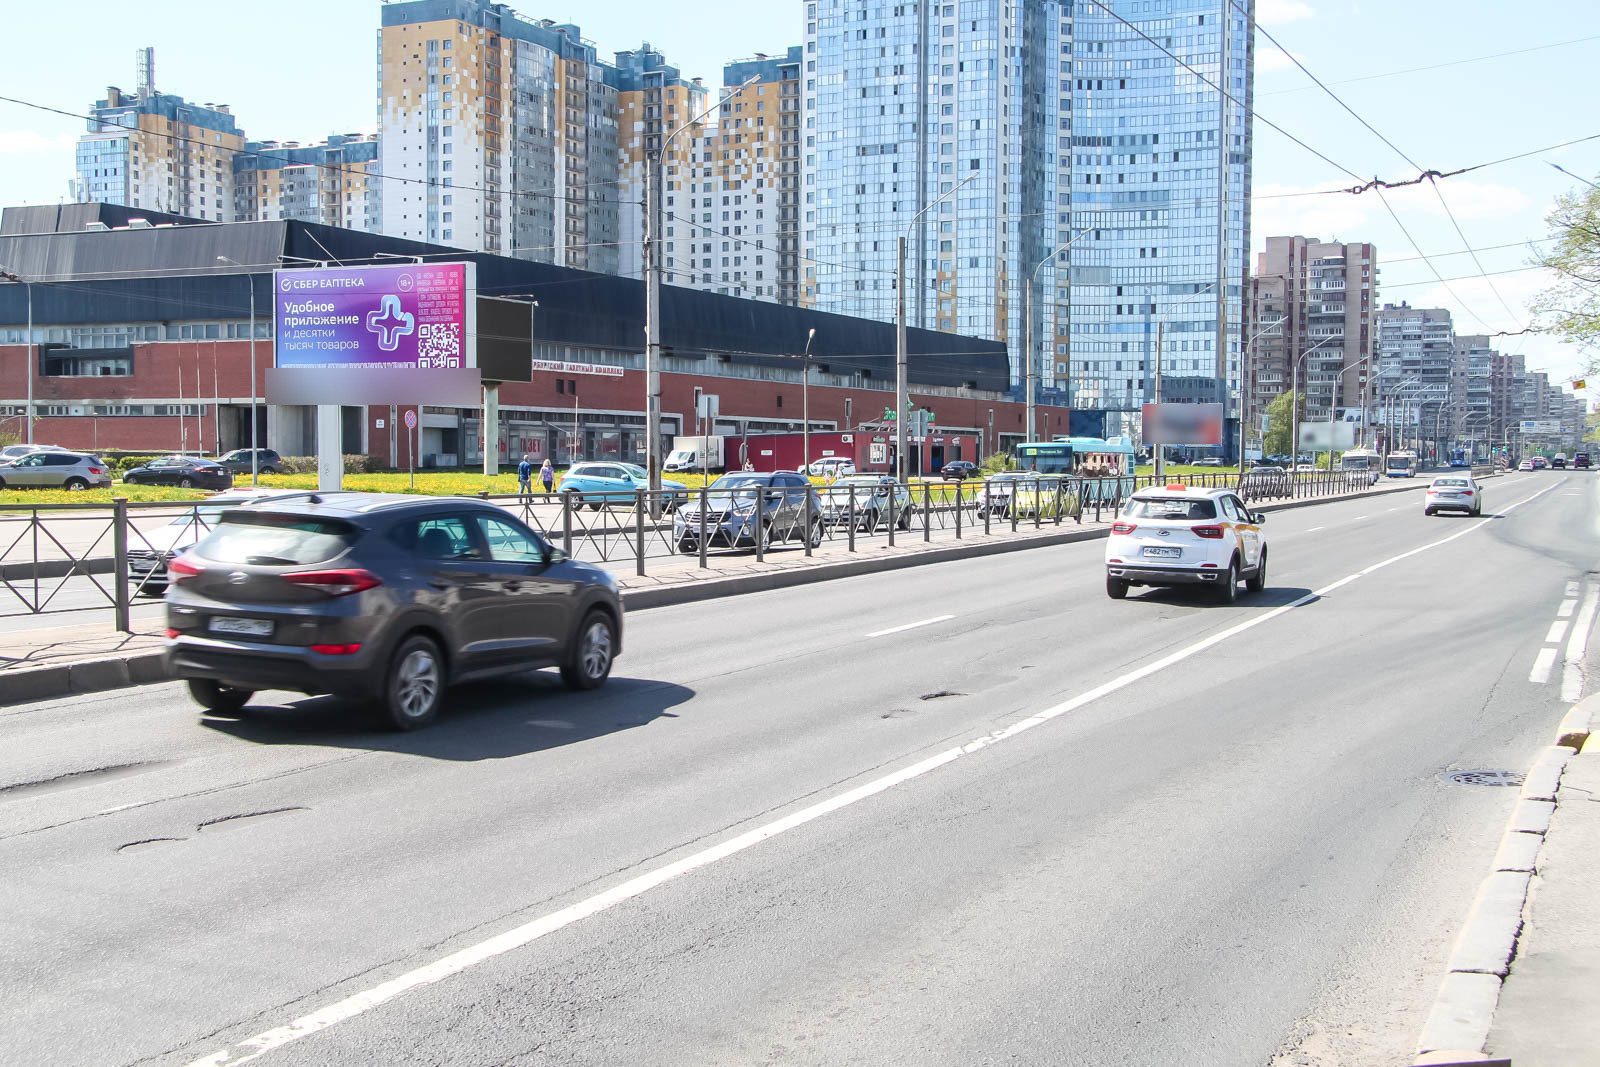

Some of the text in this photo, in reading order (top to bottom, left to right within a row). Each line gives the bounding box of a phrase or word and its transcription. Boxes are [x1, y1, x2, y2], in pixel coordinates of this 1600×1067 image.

[293, 278, 365, 289] СБЕР ЕАПТЕКА
[400, 279, 411, 287] 18+
[284, 300, 335, 315] Удобное
[284, 315, 360, 328] приложение
[284, 329, 336, 340] и десятки
[284, 340, 360, 351] тысяч товаров
